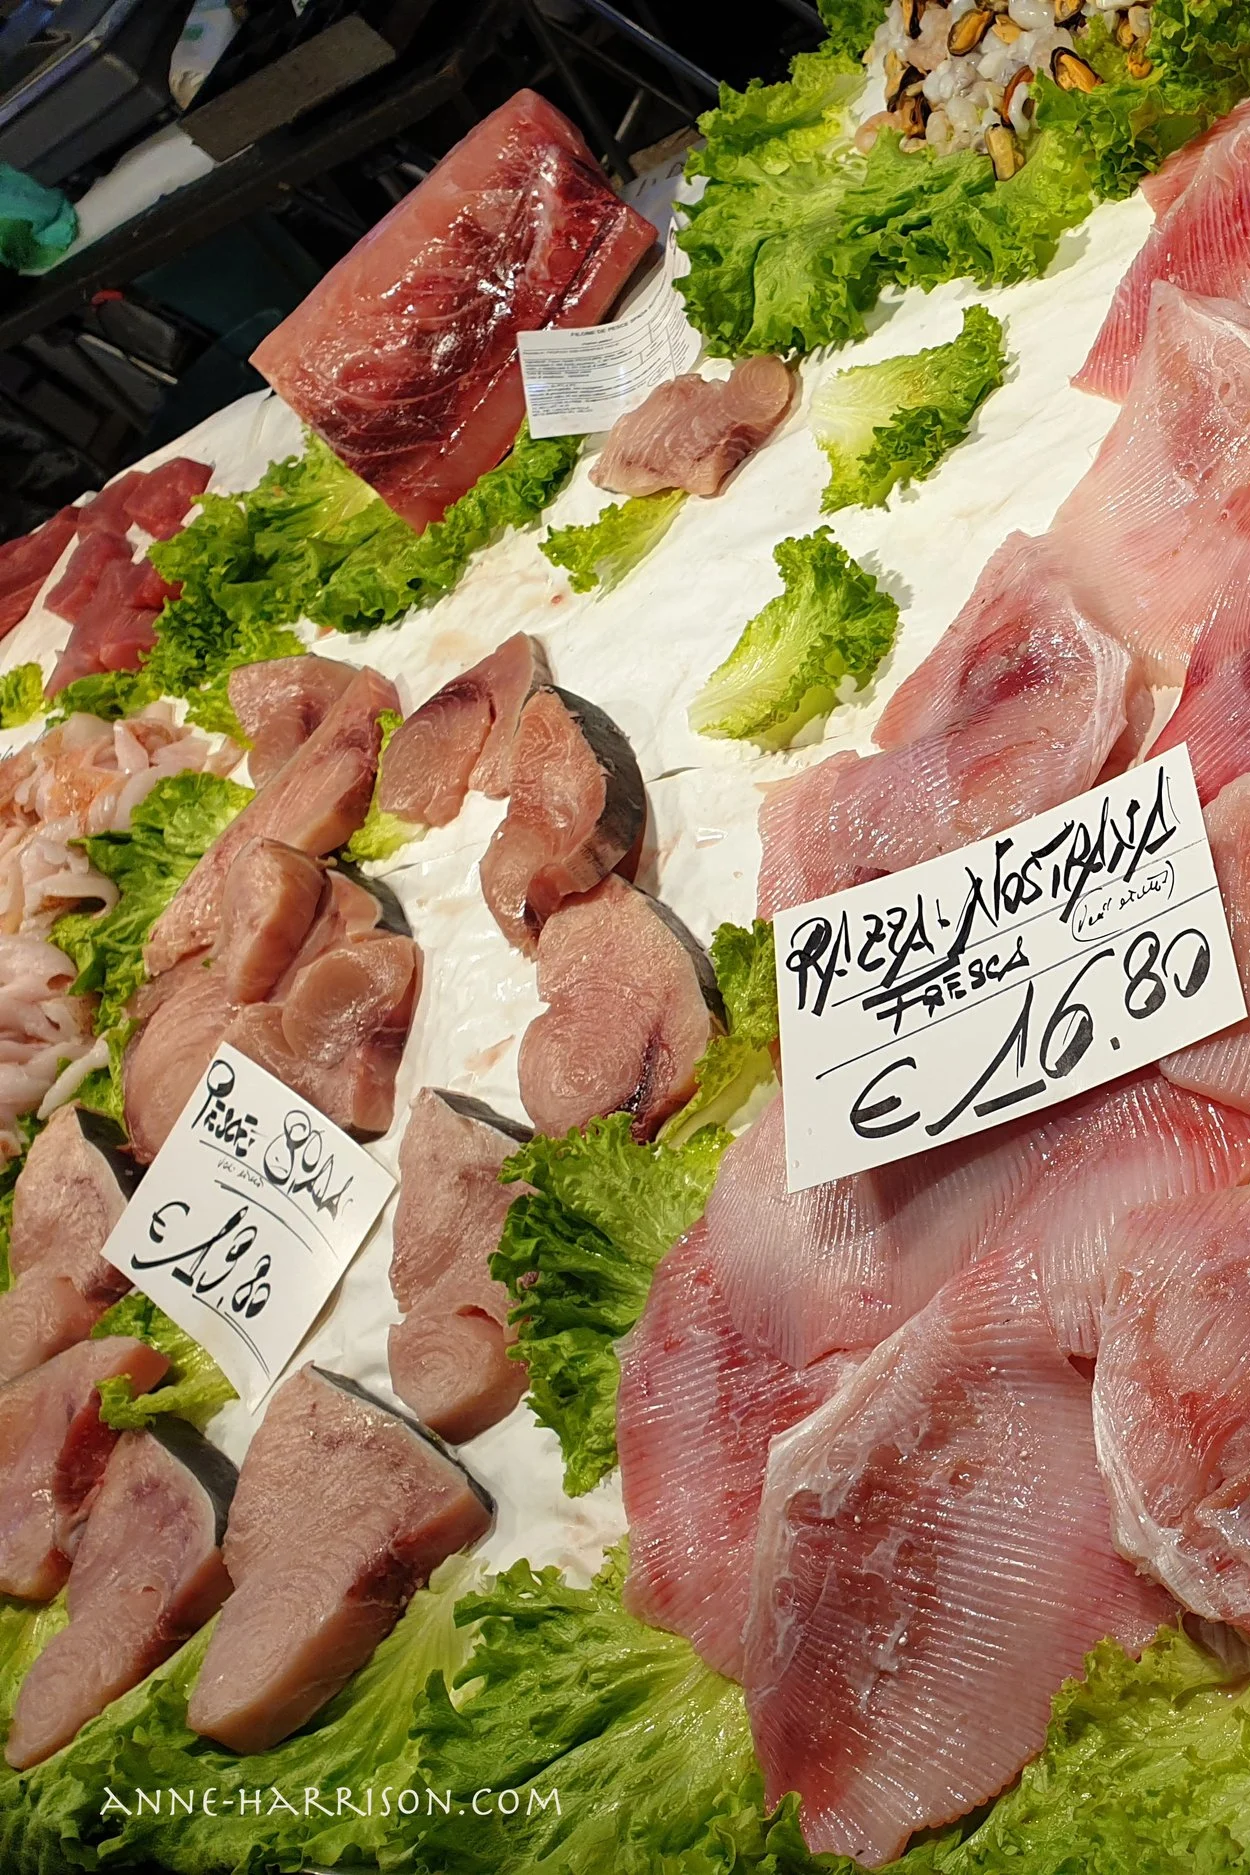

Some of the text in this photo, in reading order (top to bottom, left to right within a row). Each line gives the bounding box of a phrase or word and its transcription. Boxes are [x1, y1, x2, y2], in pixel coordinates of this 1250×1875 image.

[785, 894, 934, 1017] RAZZA
[849, 1057, 921, 1139] €
[149, 1200, 191, 1243] €
